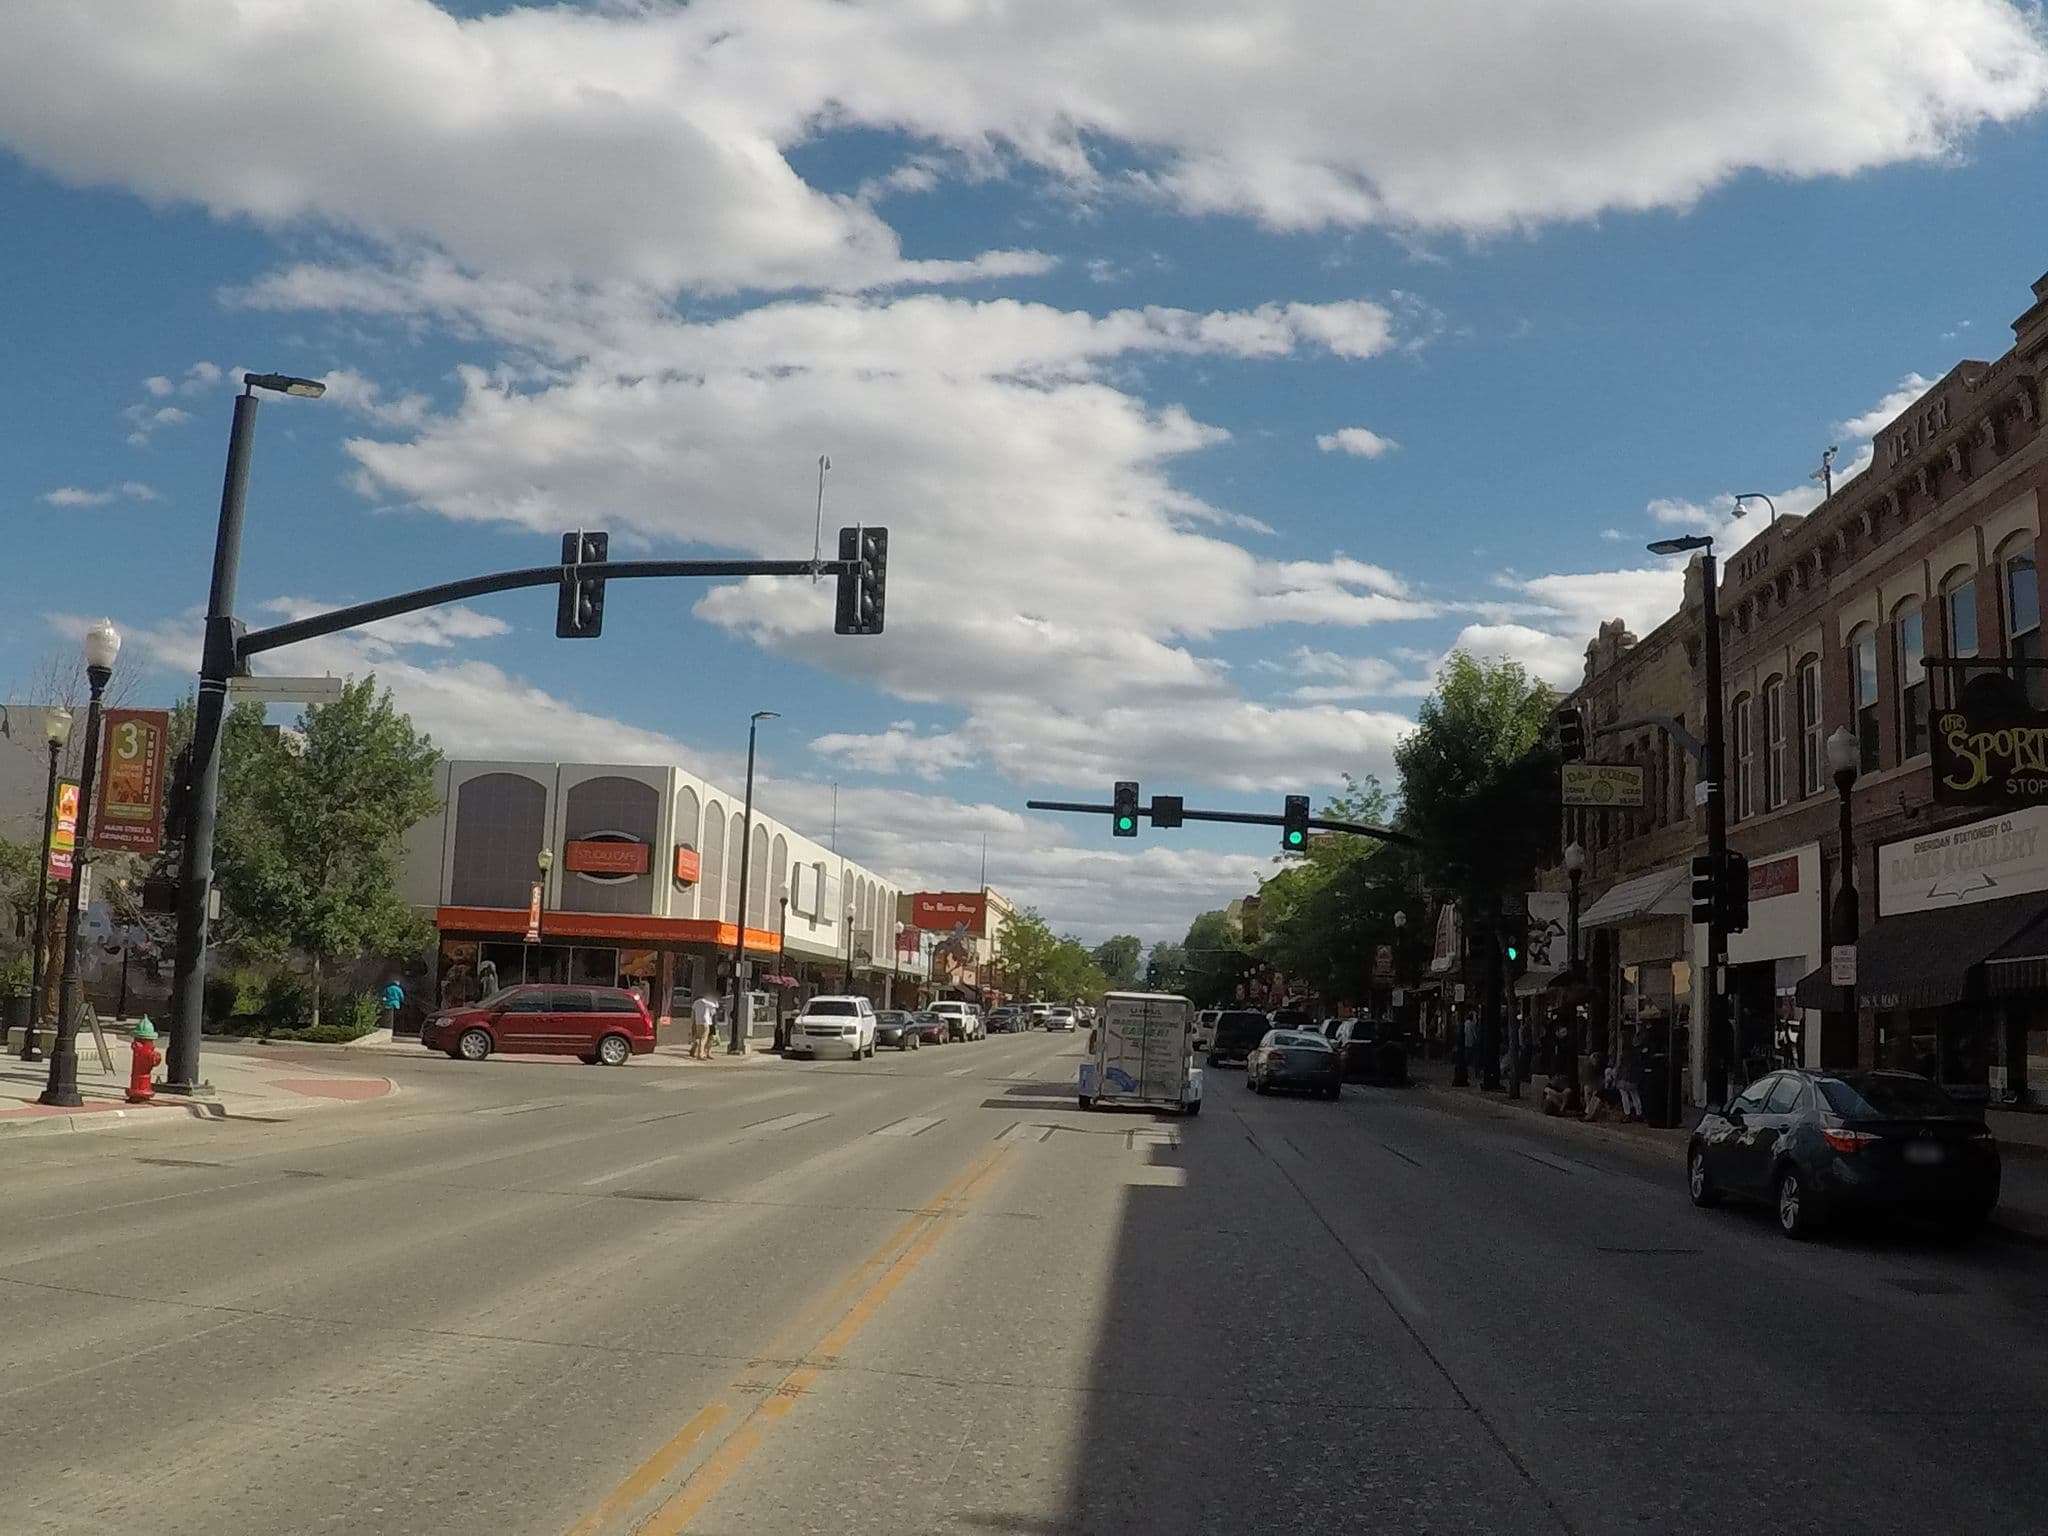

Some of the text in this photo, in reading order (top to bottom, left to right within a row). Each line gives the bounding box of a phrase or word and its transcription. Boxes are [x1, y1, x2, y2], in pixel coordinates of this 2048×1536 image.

[1888, 396, 1948, 469] MEYER
[1913, 837, 1951, 855] SHERIDAN
[1952, 825, 1999, 846] STATIONERY
